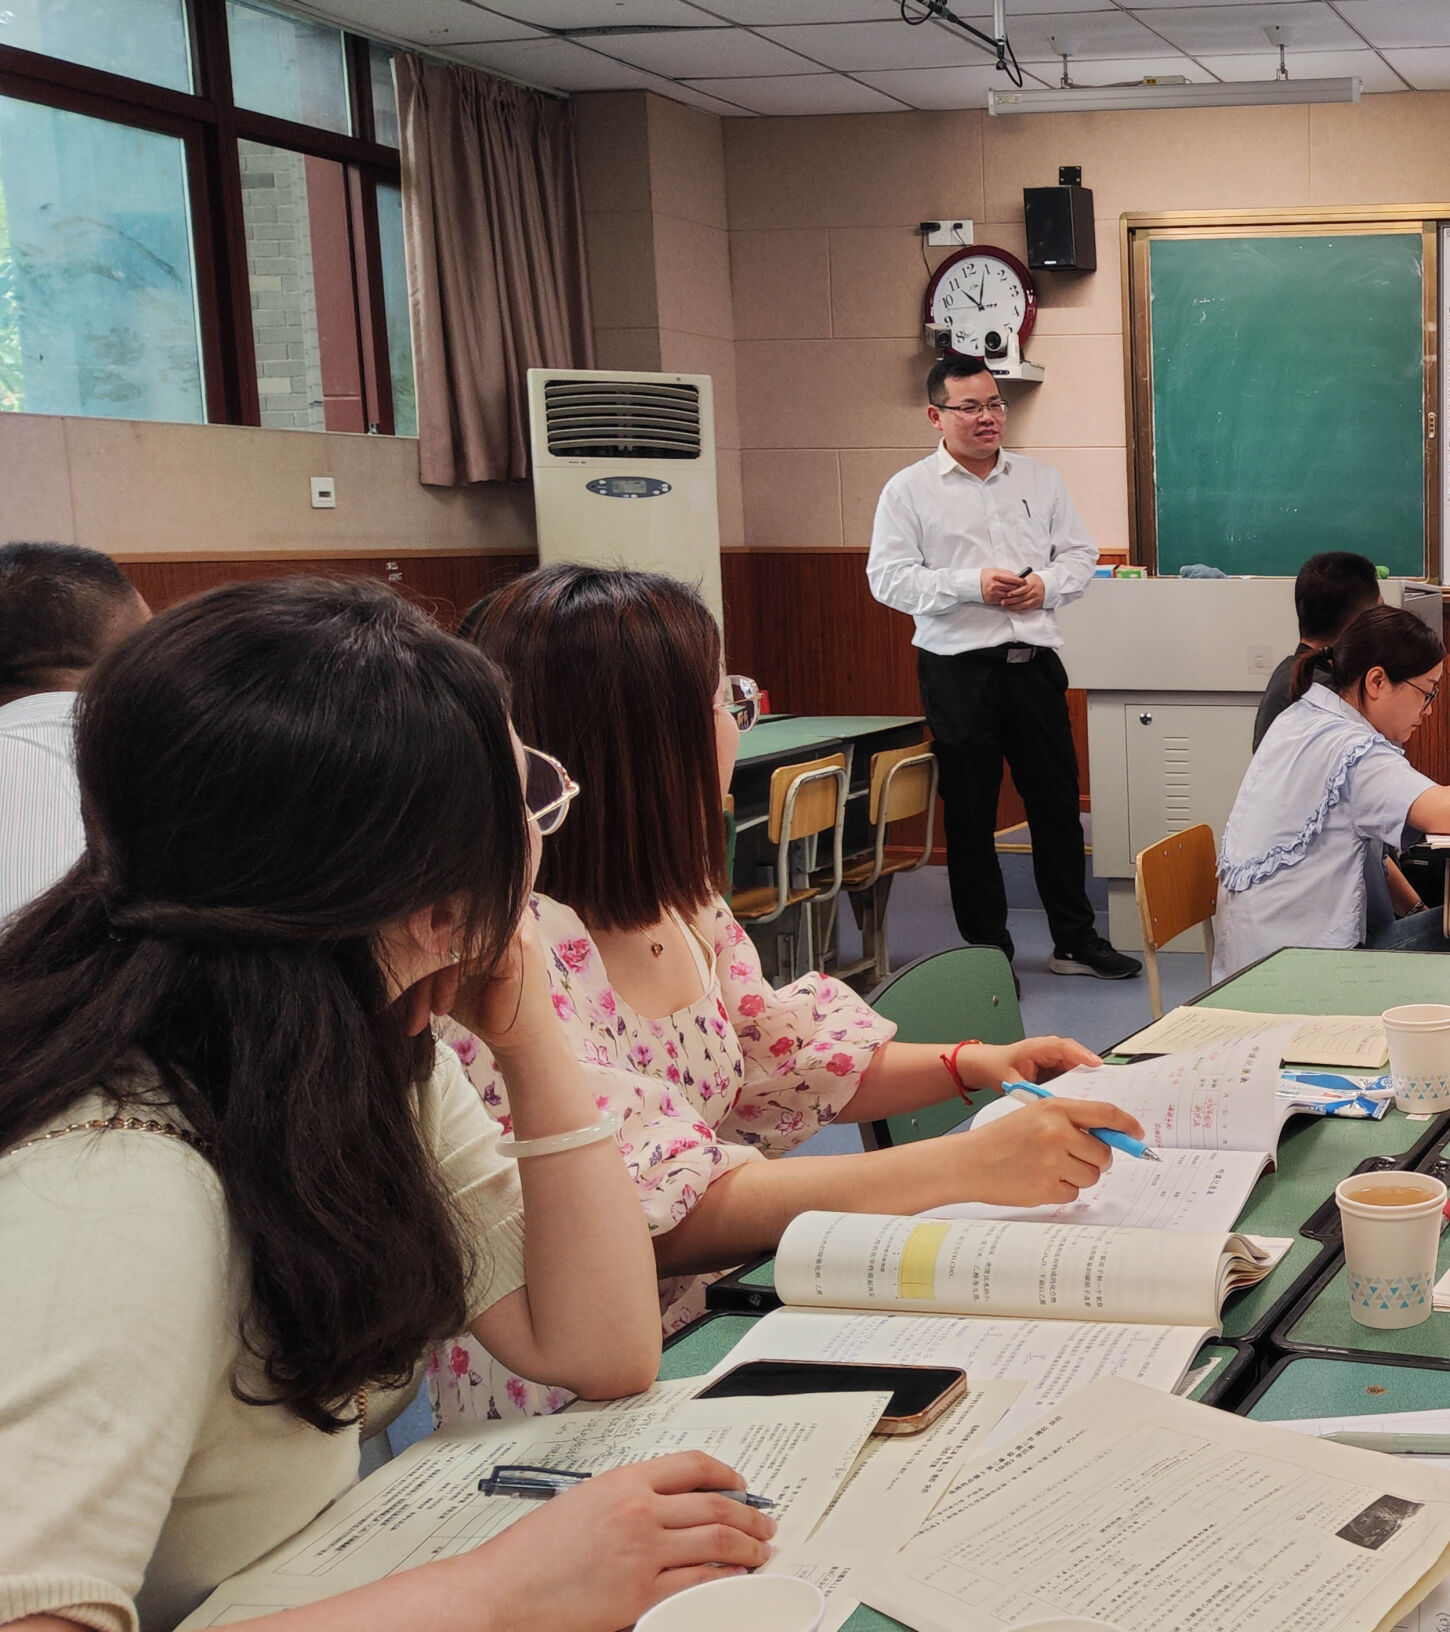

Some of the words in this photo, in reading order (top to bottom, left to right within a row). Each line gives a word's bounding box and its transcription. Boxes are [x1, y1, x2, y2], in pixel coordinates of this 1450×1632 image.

[962, 263, 977, 278] 12
[984, 264, 991, 275] 1
[997, 270, 1008, 282] 2
[948, 278, 961, 292] 11
[1009, 285, 1020, 297] 3
[941, 294, 954, 309] 10
[943, 315, 954, 328] 9
[955, 330, 966, 344] 8
[970, 338, 979, 350] 7
